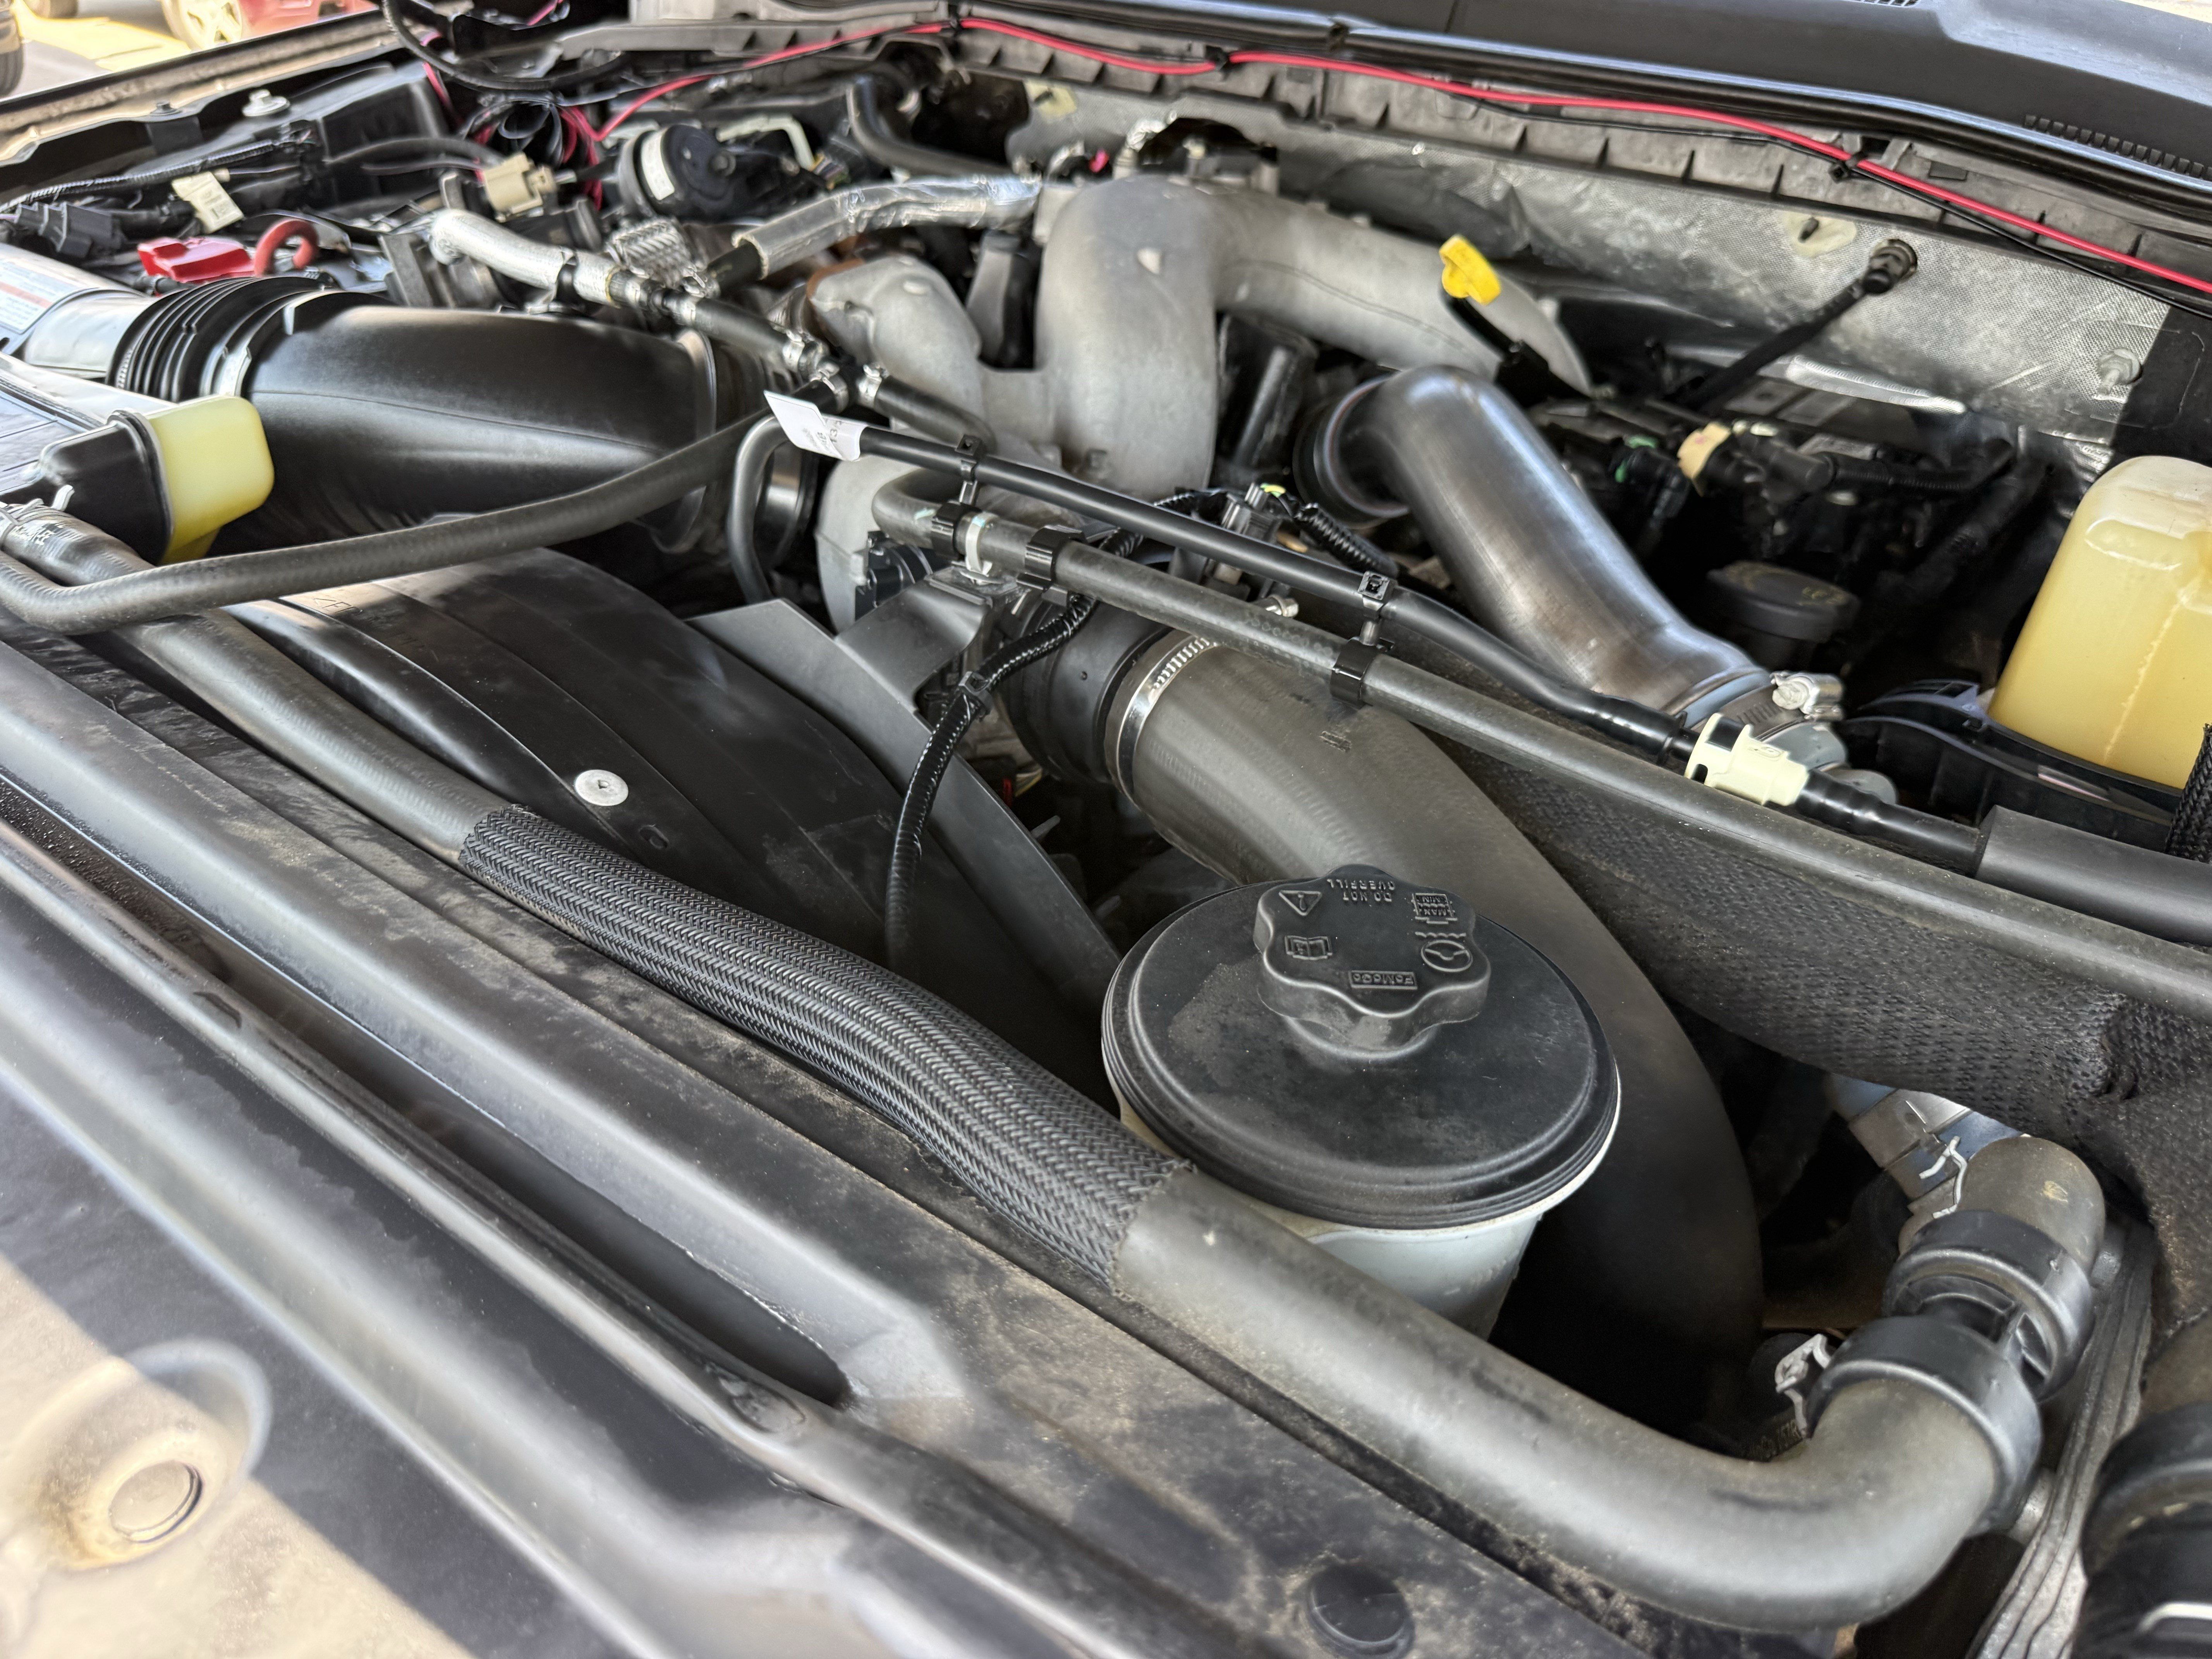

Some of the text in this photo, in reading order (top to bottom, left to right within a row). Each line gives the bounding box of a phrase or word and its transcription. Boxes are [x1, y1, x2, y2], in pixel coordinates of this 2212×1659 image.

[1327, 879, 1395, 890] OVERFILL
[1343, 891, 1392, 902] DO NOT
